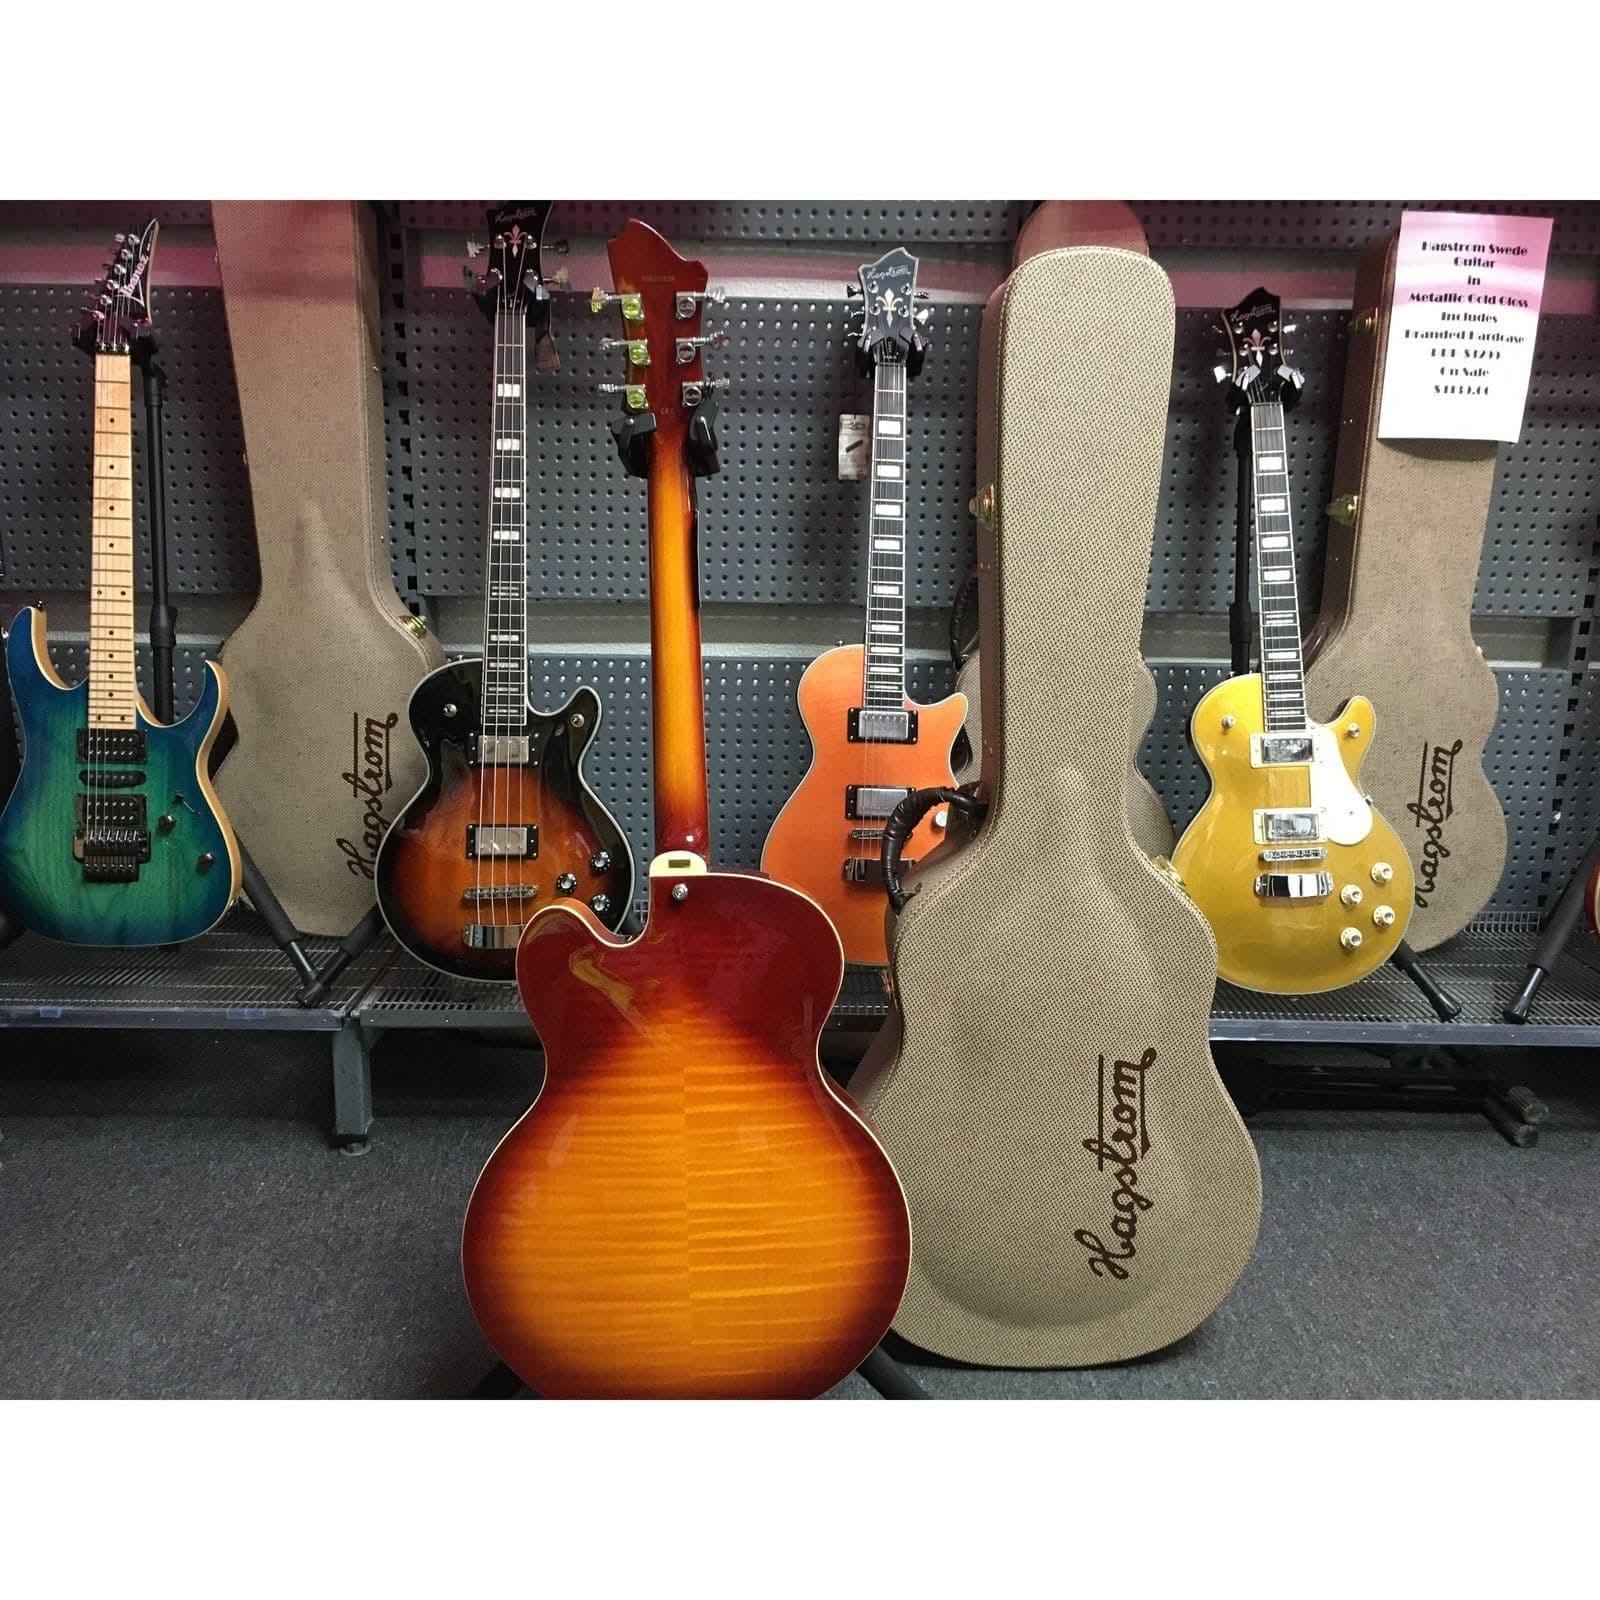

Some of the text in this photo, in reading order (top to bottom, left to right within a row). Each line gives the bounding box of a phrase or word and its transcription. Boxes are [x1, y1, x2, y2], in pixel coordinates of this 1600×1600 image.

[1454, 256, 1496, 269] Guitar
[1409, 293, 1529, 308] Metallic Gold Gloss
[1073, 1047, 1158, 1281] Hagstrom
